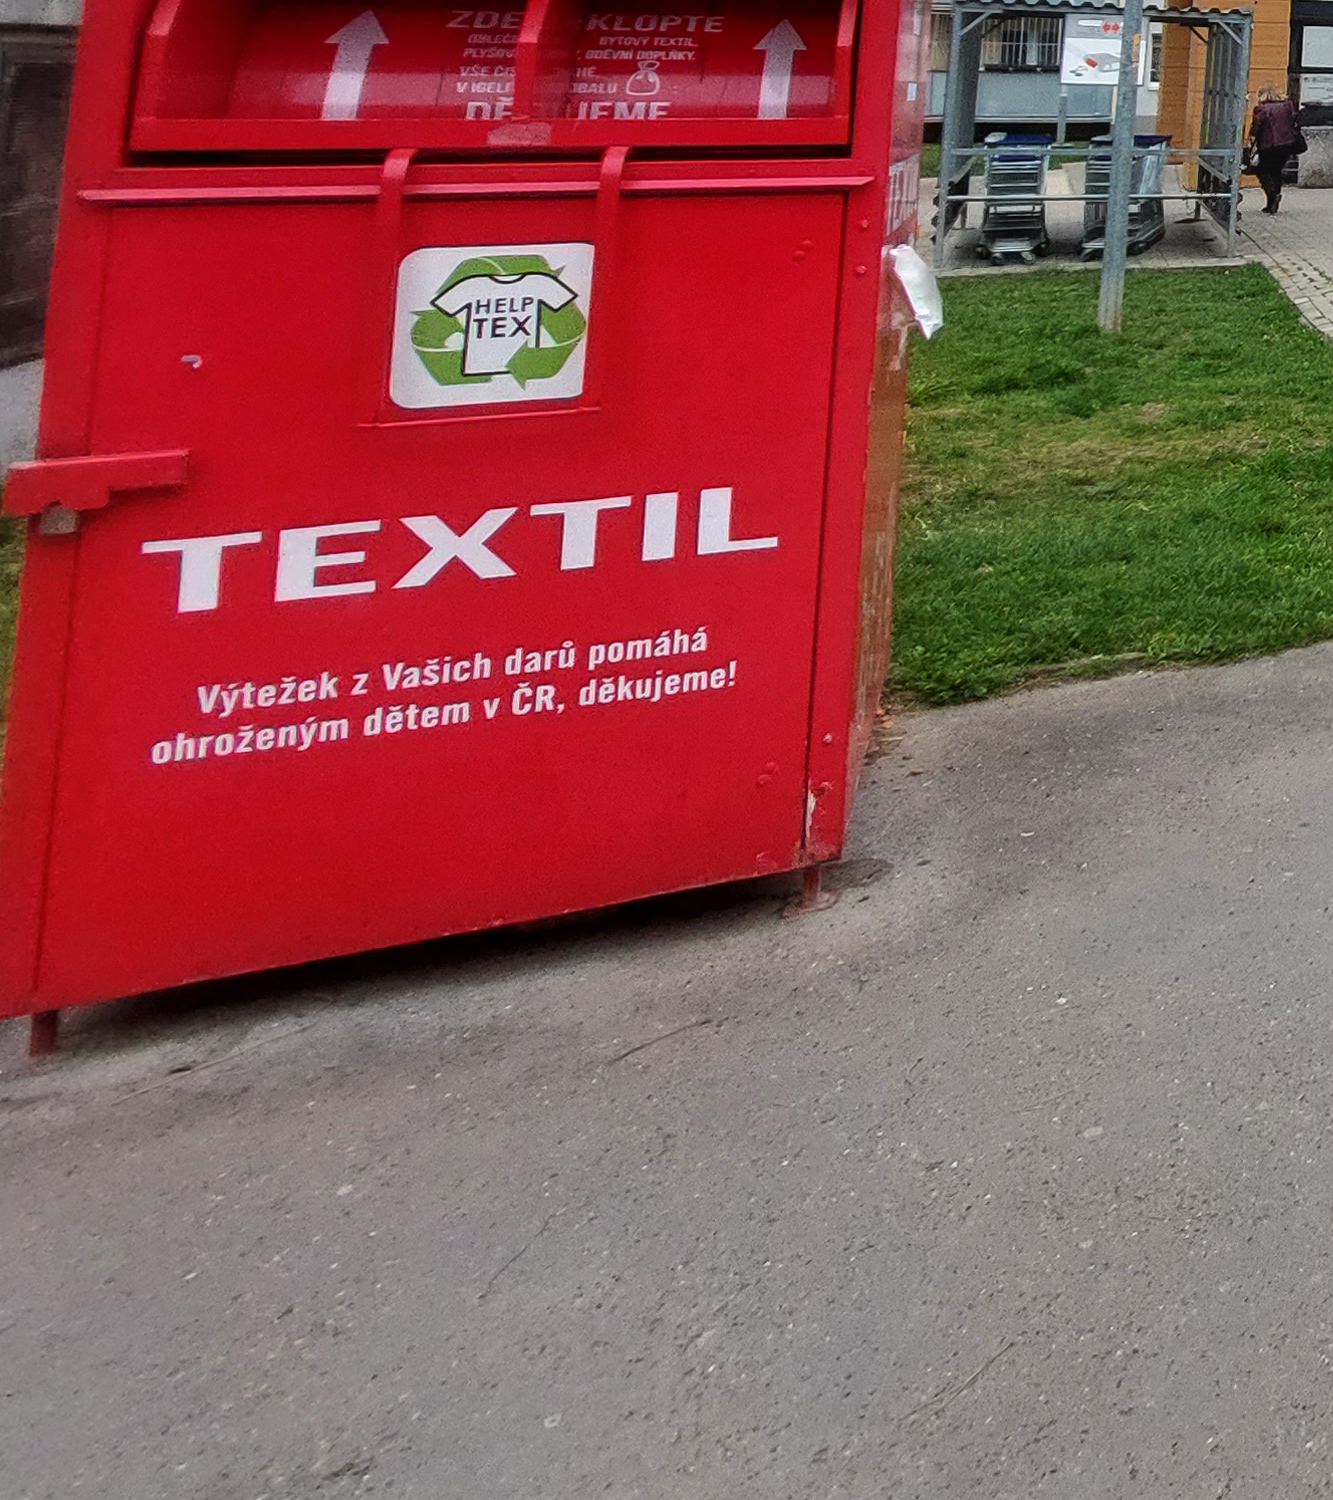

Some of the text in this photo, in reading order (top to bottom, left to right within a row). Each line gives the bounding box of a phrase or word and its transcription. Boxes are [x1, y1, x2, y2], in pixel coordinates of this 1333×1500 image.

[445, 10, 726, 33] ZDE KLOPTE
[460, 64, 490, 77] VŠE
[456, 81, 468, 94] V
[470, 81, 513, 94] IGELI
[475, 296, 534, 314] HELP
[473, 315, 532, 339] TEX
[141, 486, 779, 613] TEXTIL
[198, 626, 709, 717] Výtežek z Vašich darů pomáhá
[151, 661, 738, 765] ohroženým dětem v ČR, děkujeme!
